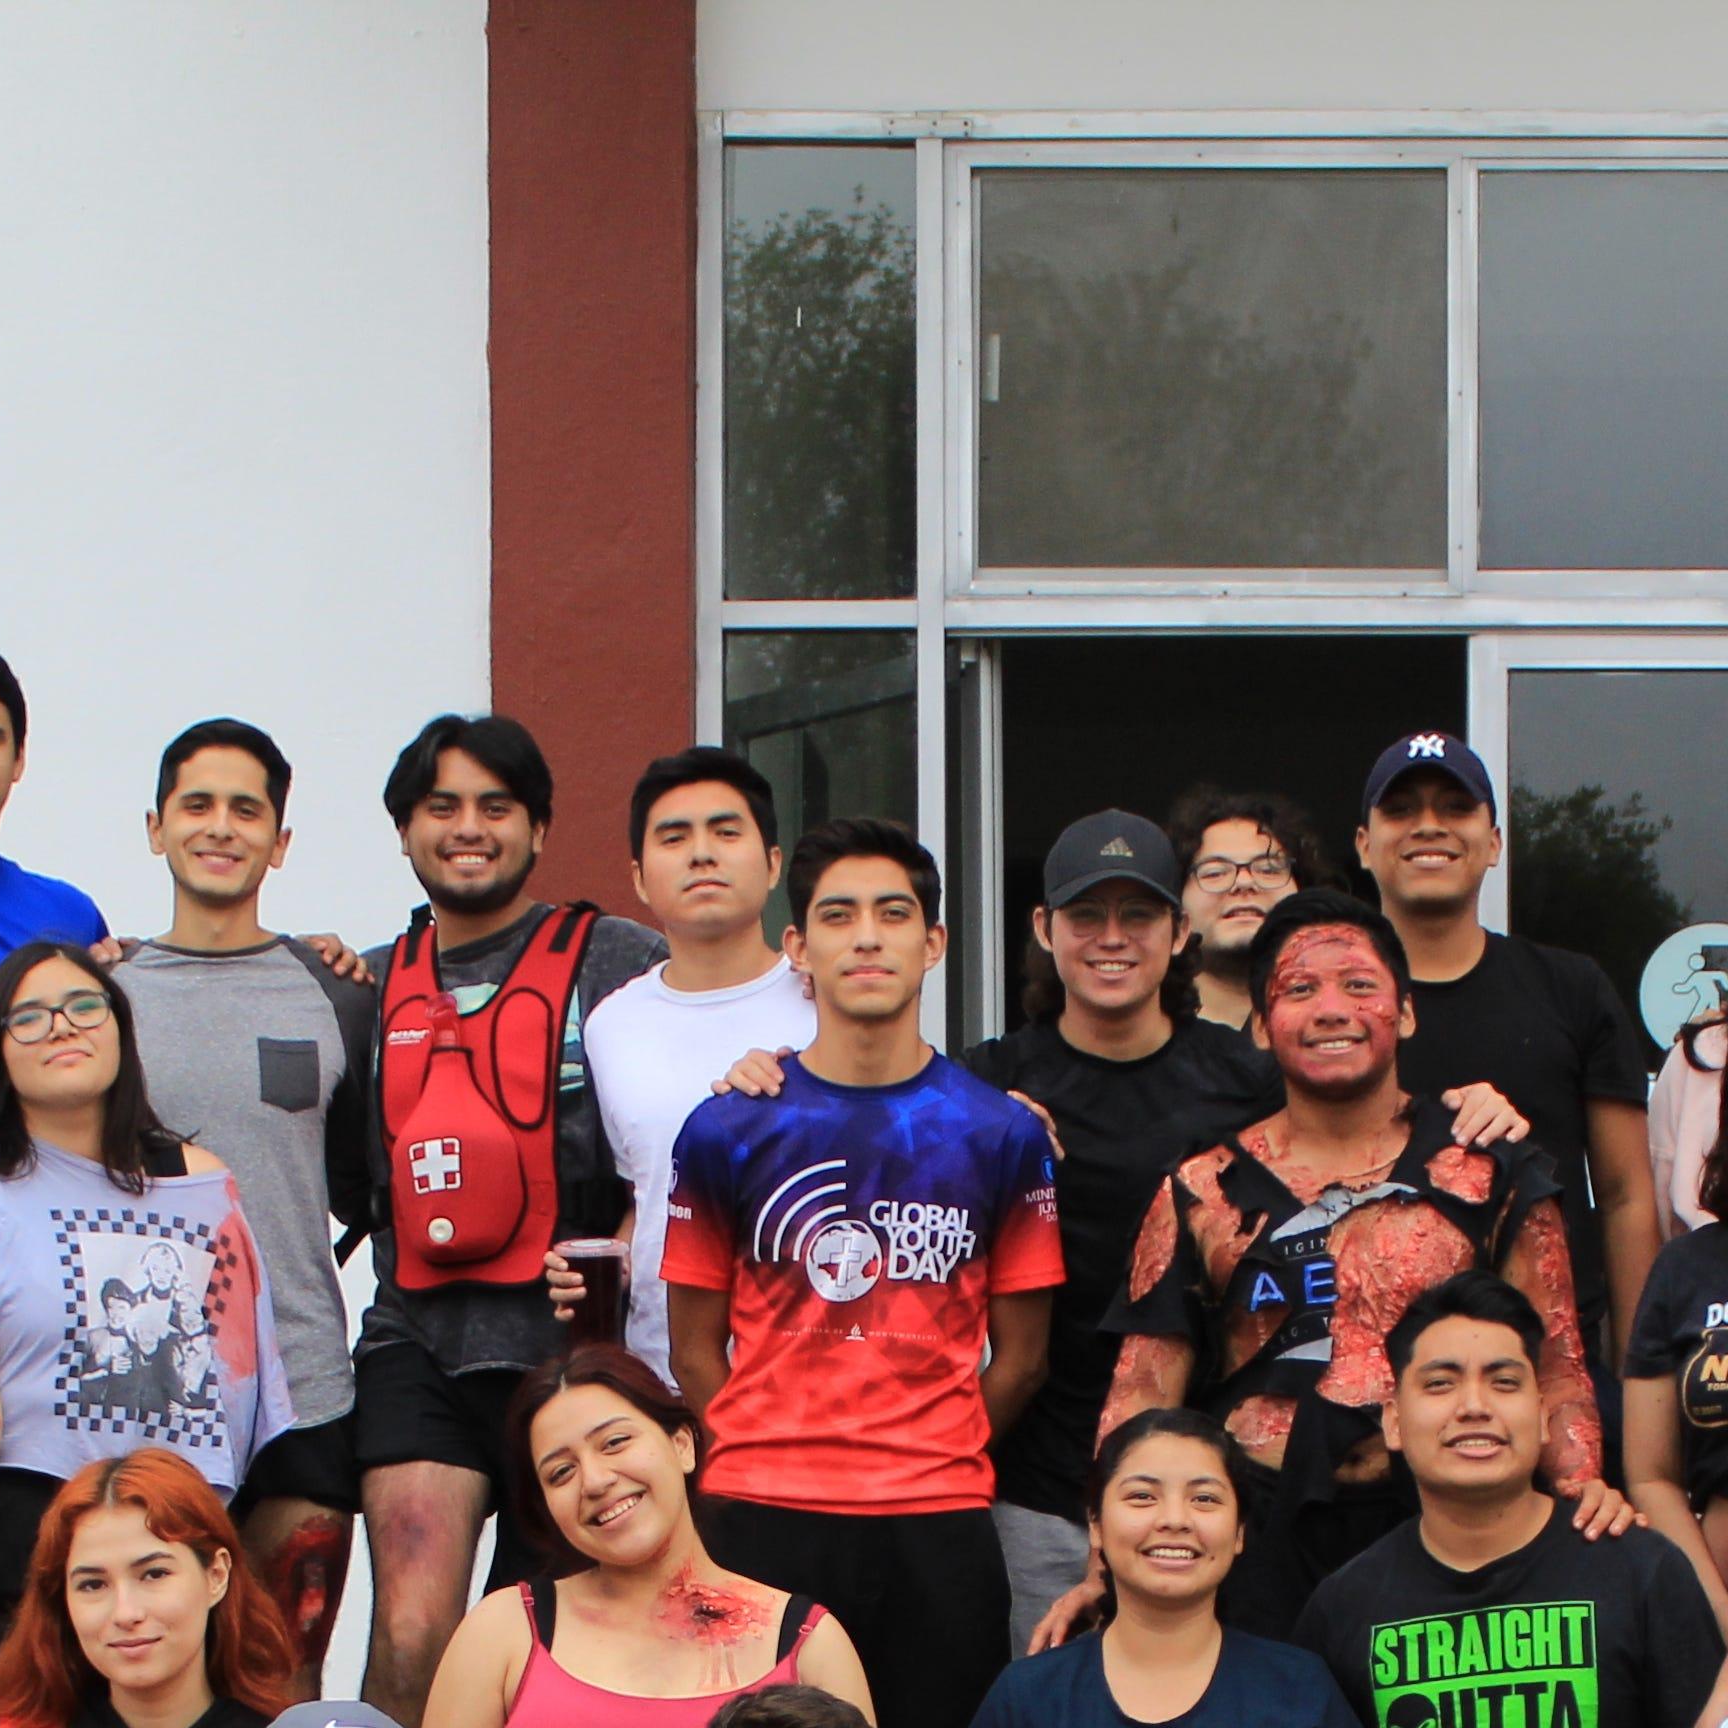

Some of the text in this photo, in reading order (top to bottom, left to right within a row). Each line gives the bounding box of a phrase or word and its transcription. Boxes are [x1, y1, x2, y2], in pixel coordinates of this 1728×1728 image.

[869, 1200, 969, 1231] GLOBAL
[885, 1226, 976, 1259] YOUTH
[887, 1248, 959, 1284] DAY
[1374, 1606, 1590, 1686] STRAIGHT
